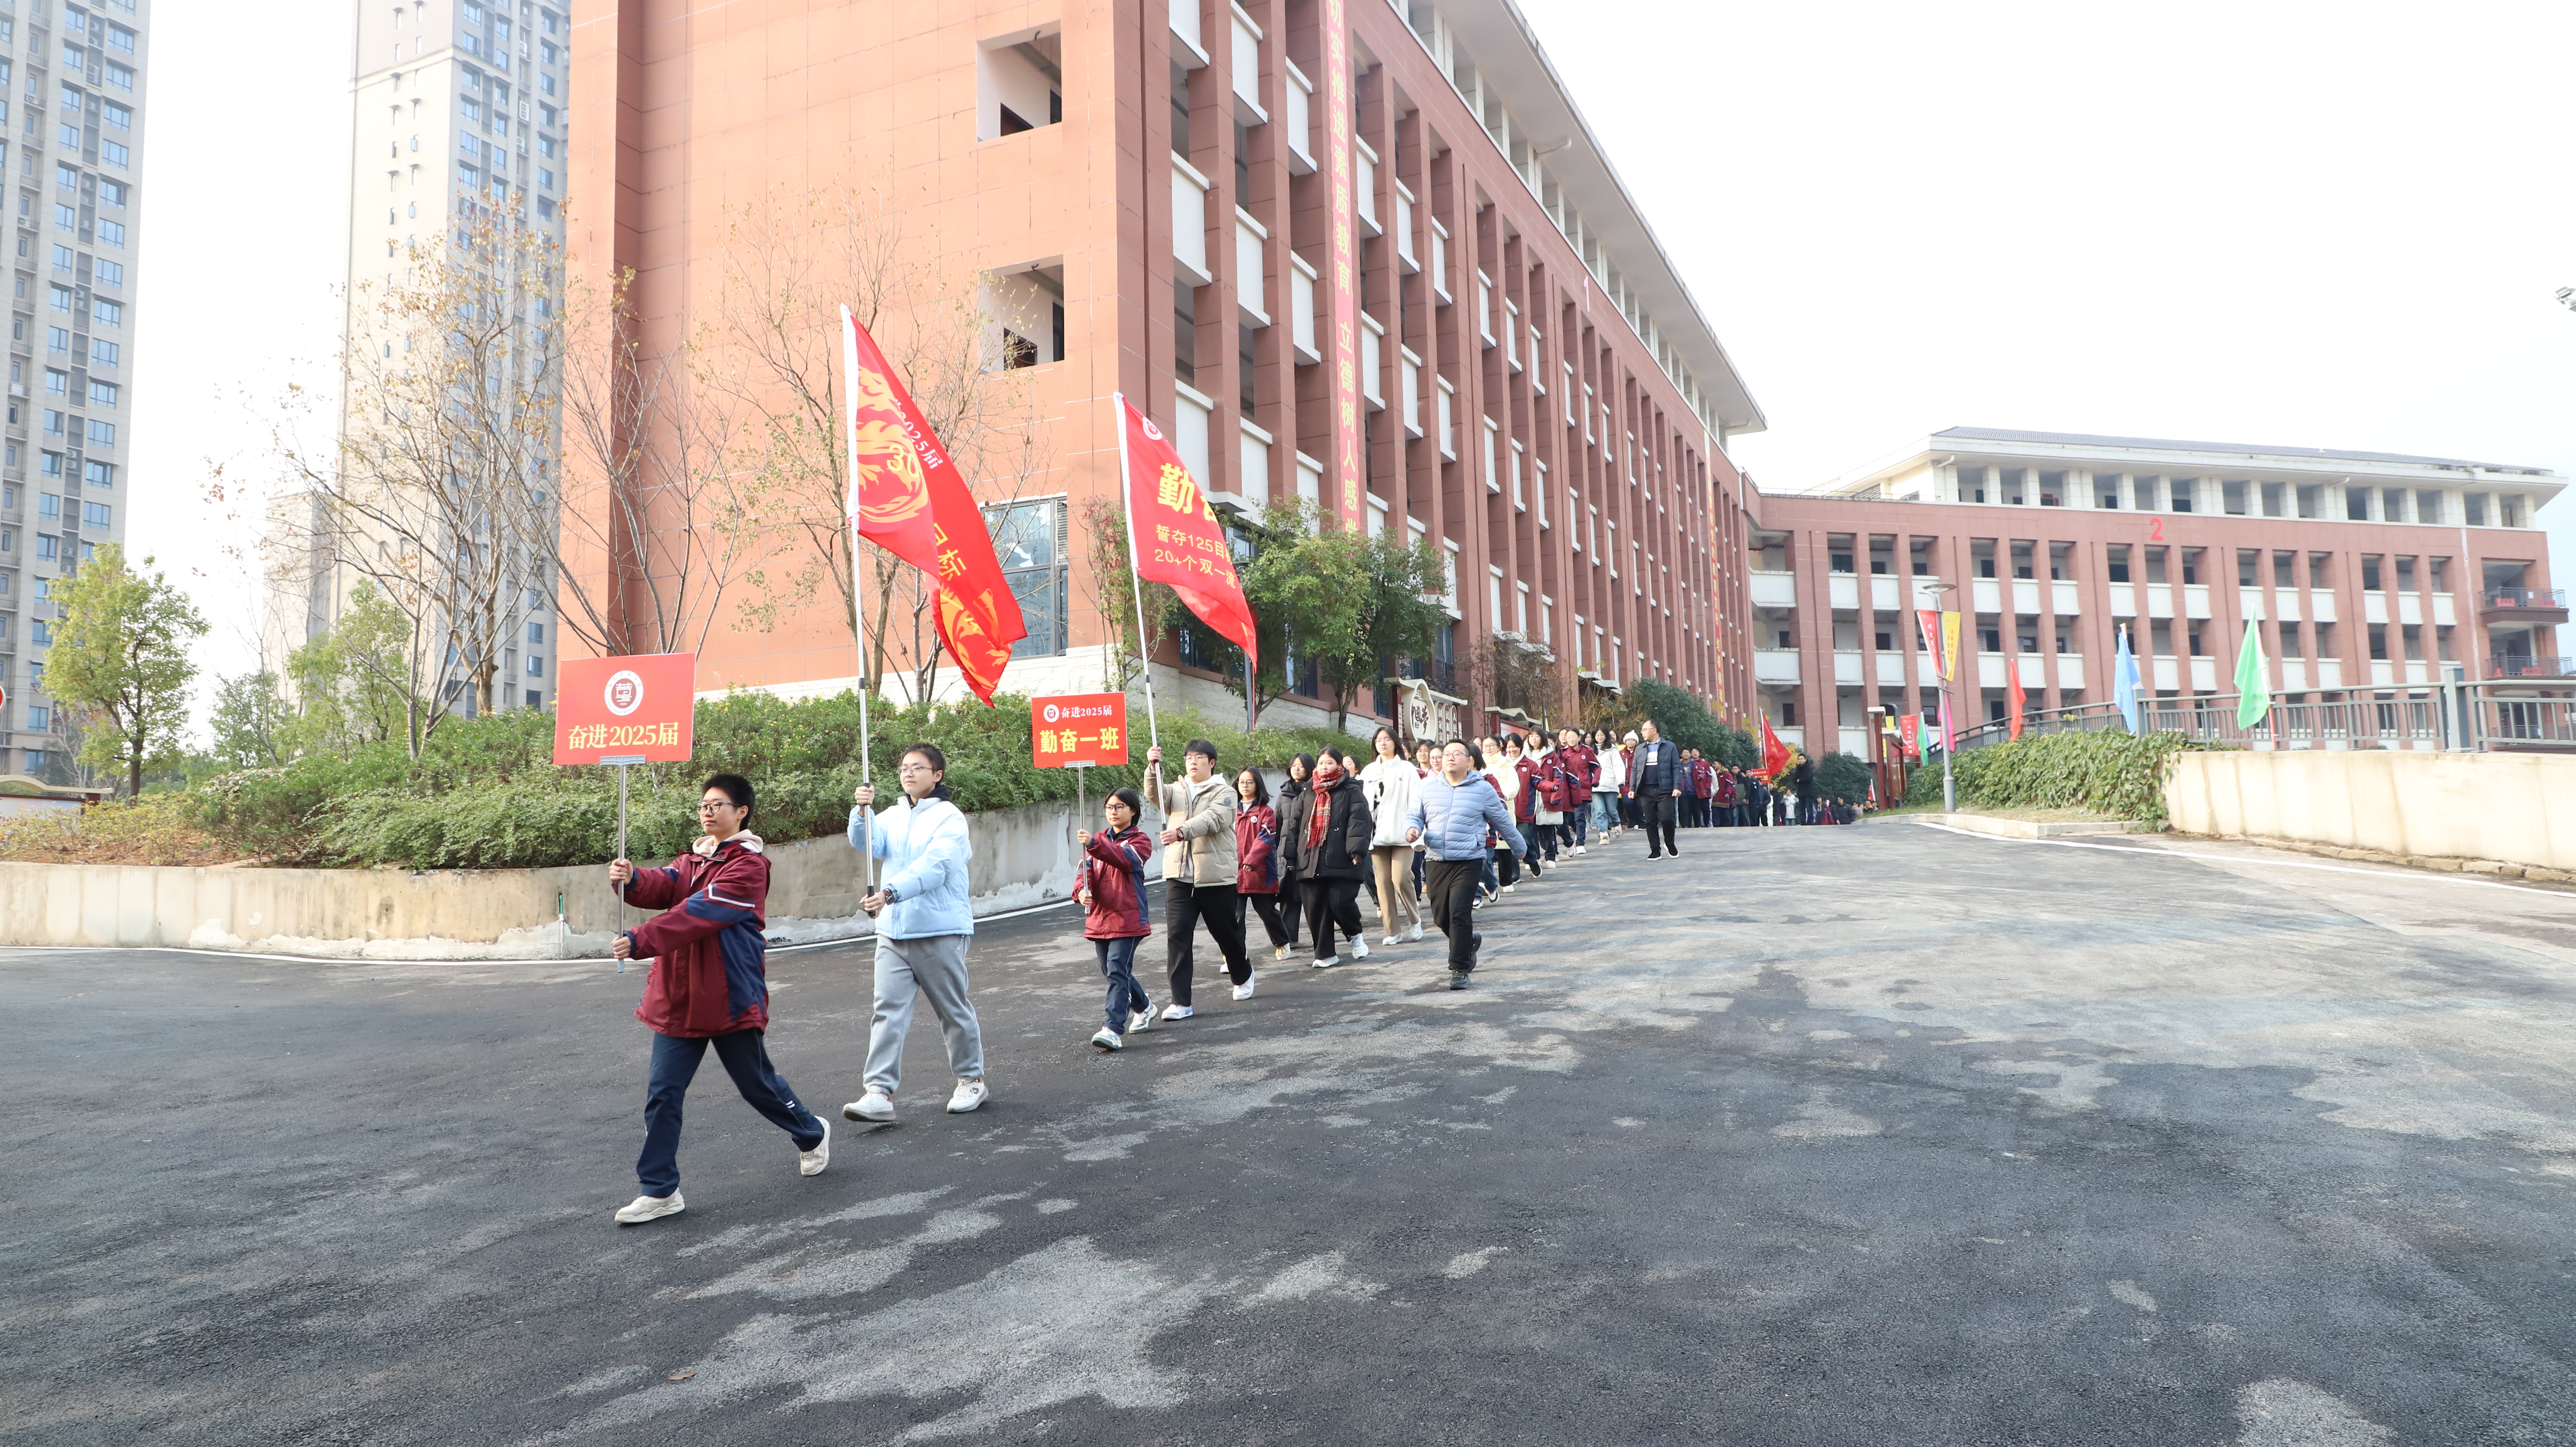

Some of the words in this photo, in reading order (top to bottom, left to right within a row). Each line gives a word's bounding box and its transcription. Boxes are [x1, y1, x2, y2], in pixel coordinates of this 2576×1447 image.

[1584, 275, 1590, 313] 1
[2150, 518, 2164, 541] 2
[1155, 549, 1236, 589] 20+个双一流
[1061, 705, 1112, 719] 奋进2025届
[568, 721, 679, 750] 奋进2025届
[1039, 726, 1120, 754] 勤奋一班
